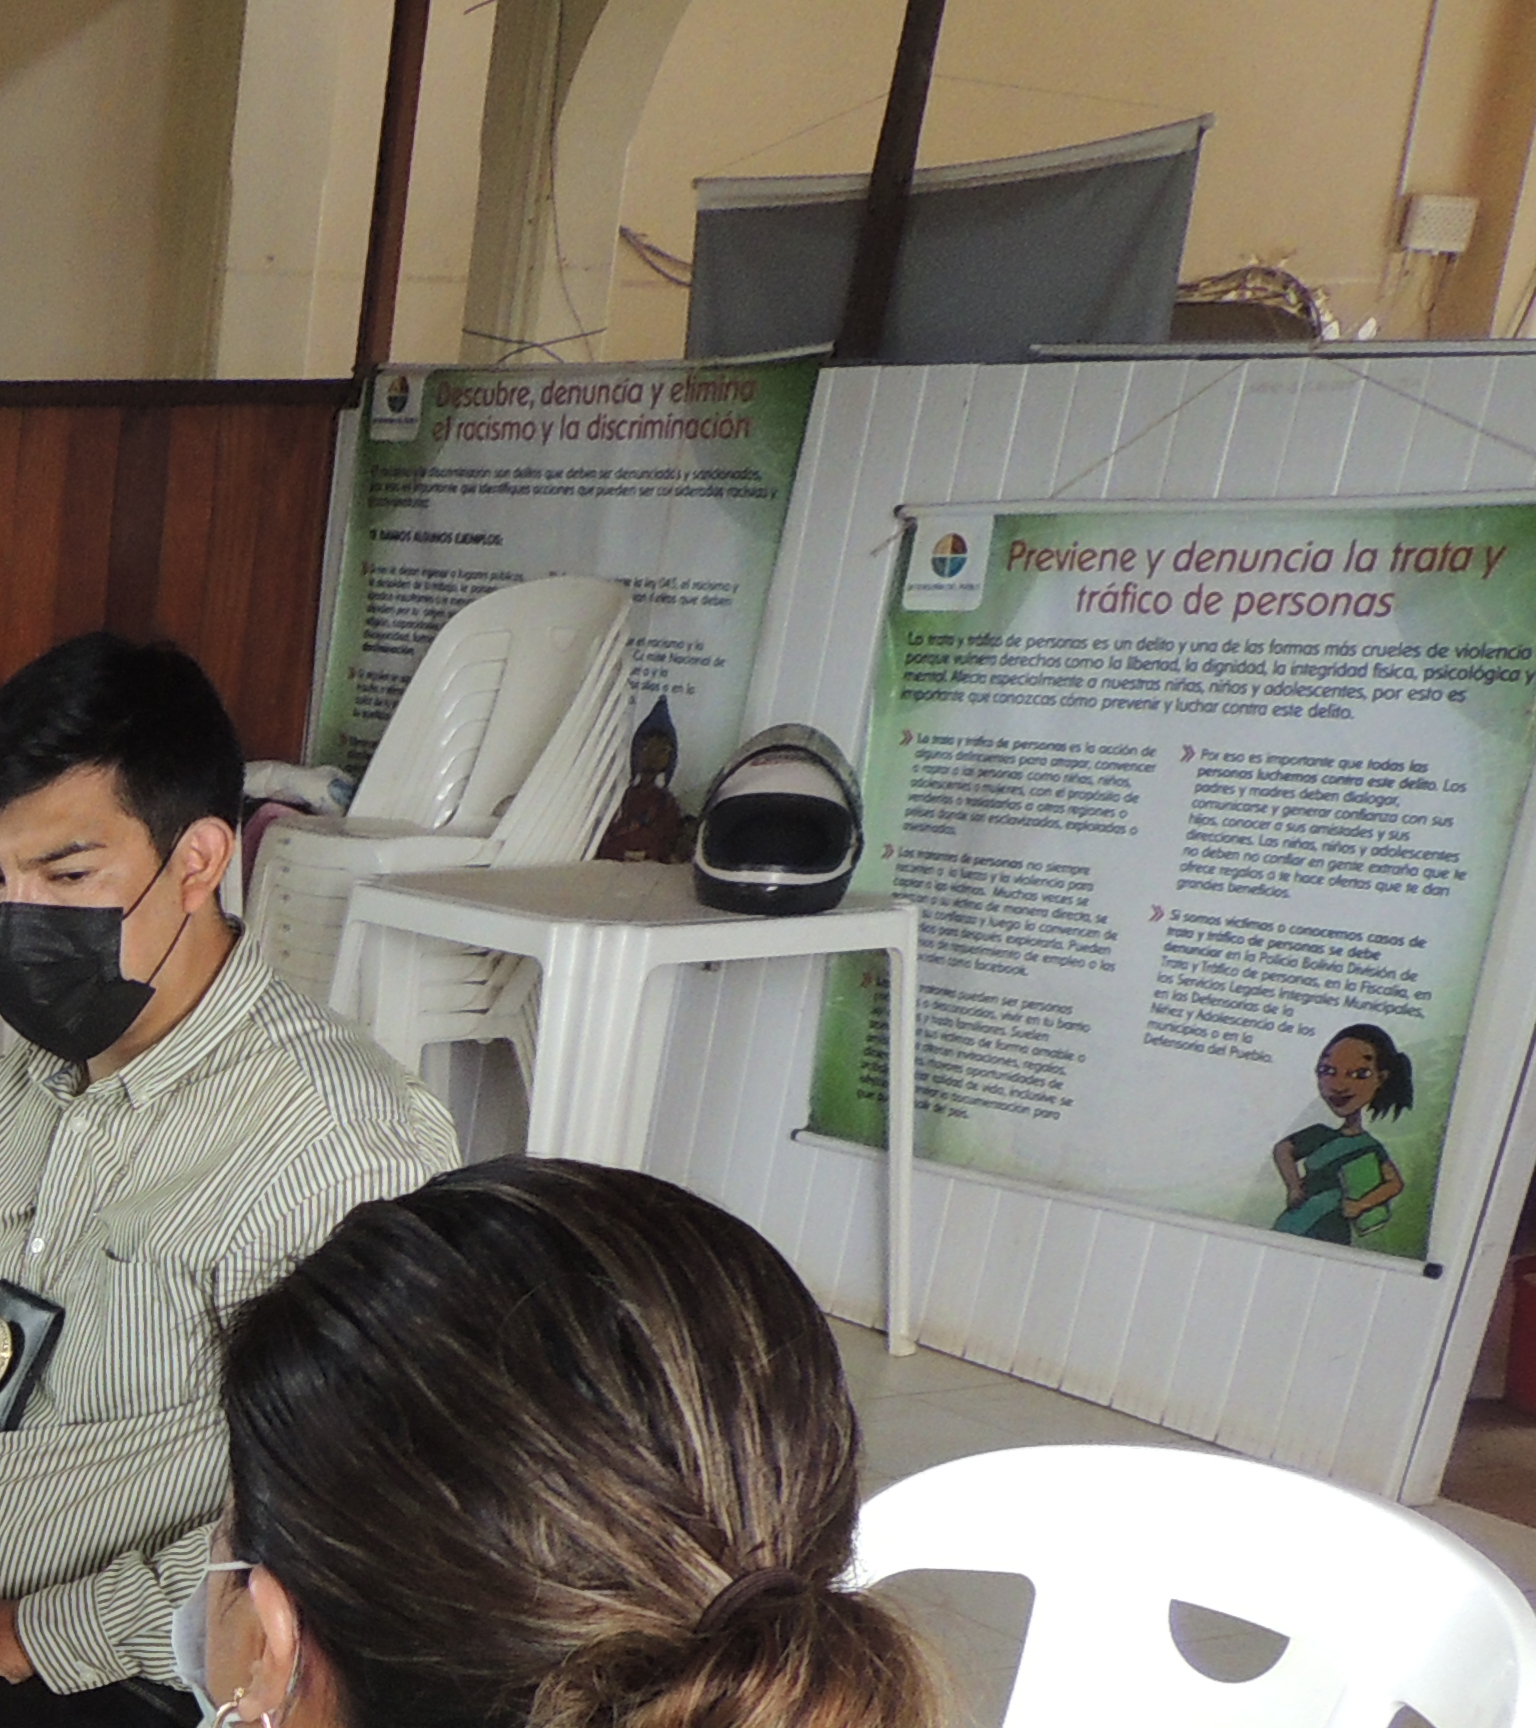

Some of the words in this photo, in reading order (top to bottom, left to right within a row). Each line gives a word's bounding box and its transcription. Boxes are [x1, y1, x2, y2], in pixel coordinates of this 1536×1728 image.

[436, 379, 535, 408] Descubre,
[651, 381, 665, 409] y
[670, 372, 758, 404] elimina
[432, 415, 451, 442] el
[456, 415, 540, 442] racismo
[541, 418, 555, 446] y
[559, 412, 581, 441] la
[586, 407, 752, 442] discriminación
[1006, 540, 1138, 573] Previene
[1146, 547, 1167, 579] y
[1172, 540, 1334, 574] denuncia
[1342, 538, 1378, 574] la
[1389, 541, 1474, 574] trata
[1481, 544, 1508, 579] y
[1075, 581, 1174, 615] tráfico
[1182, 582, 1224, 617] de
[1231, 589, 1396, 622] personas
